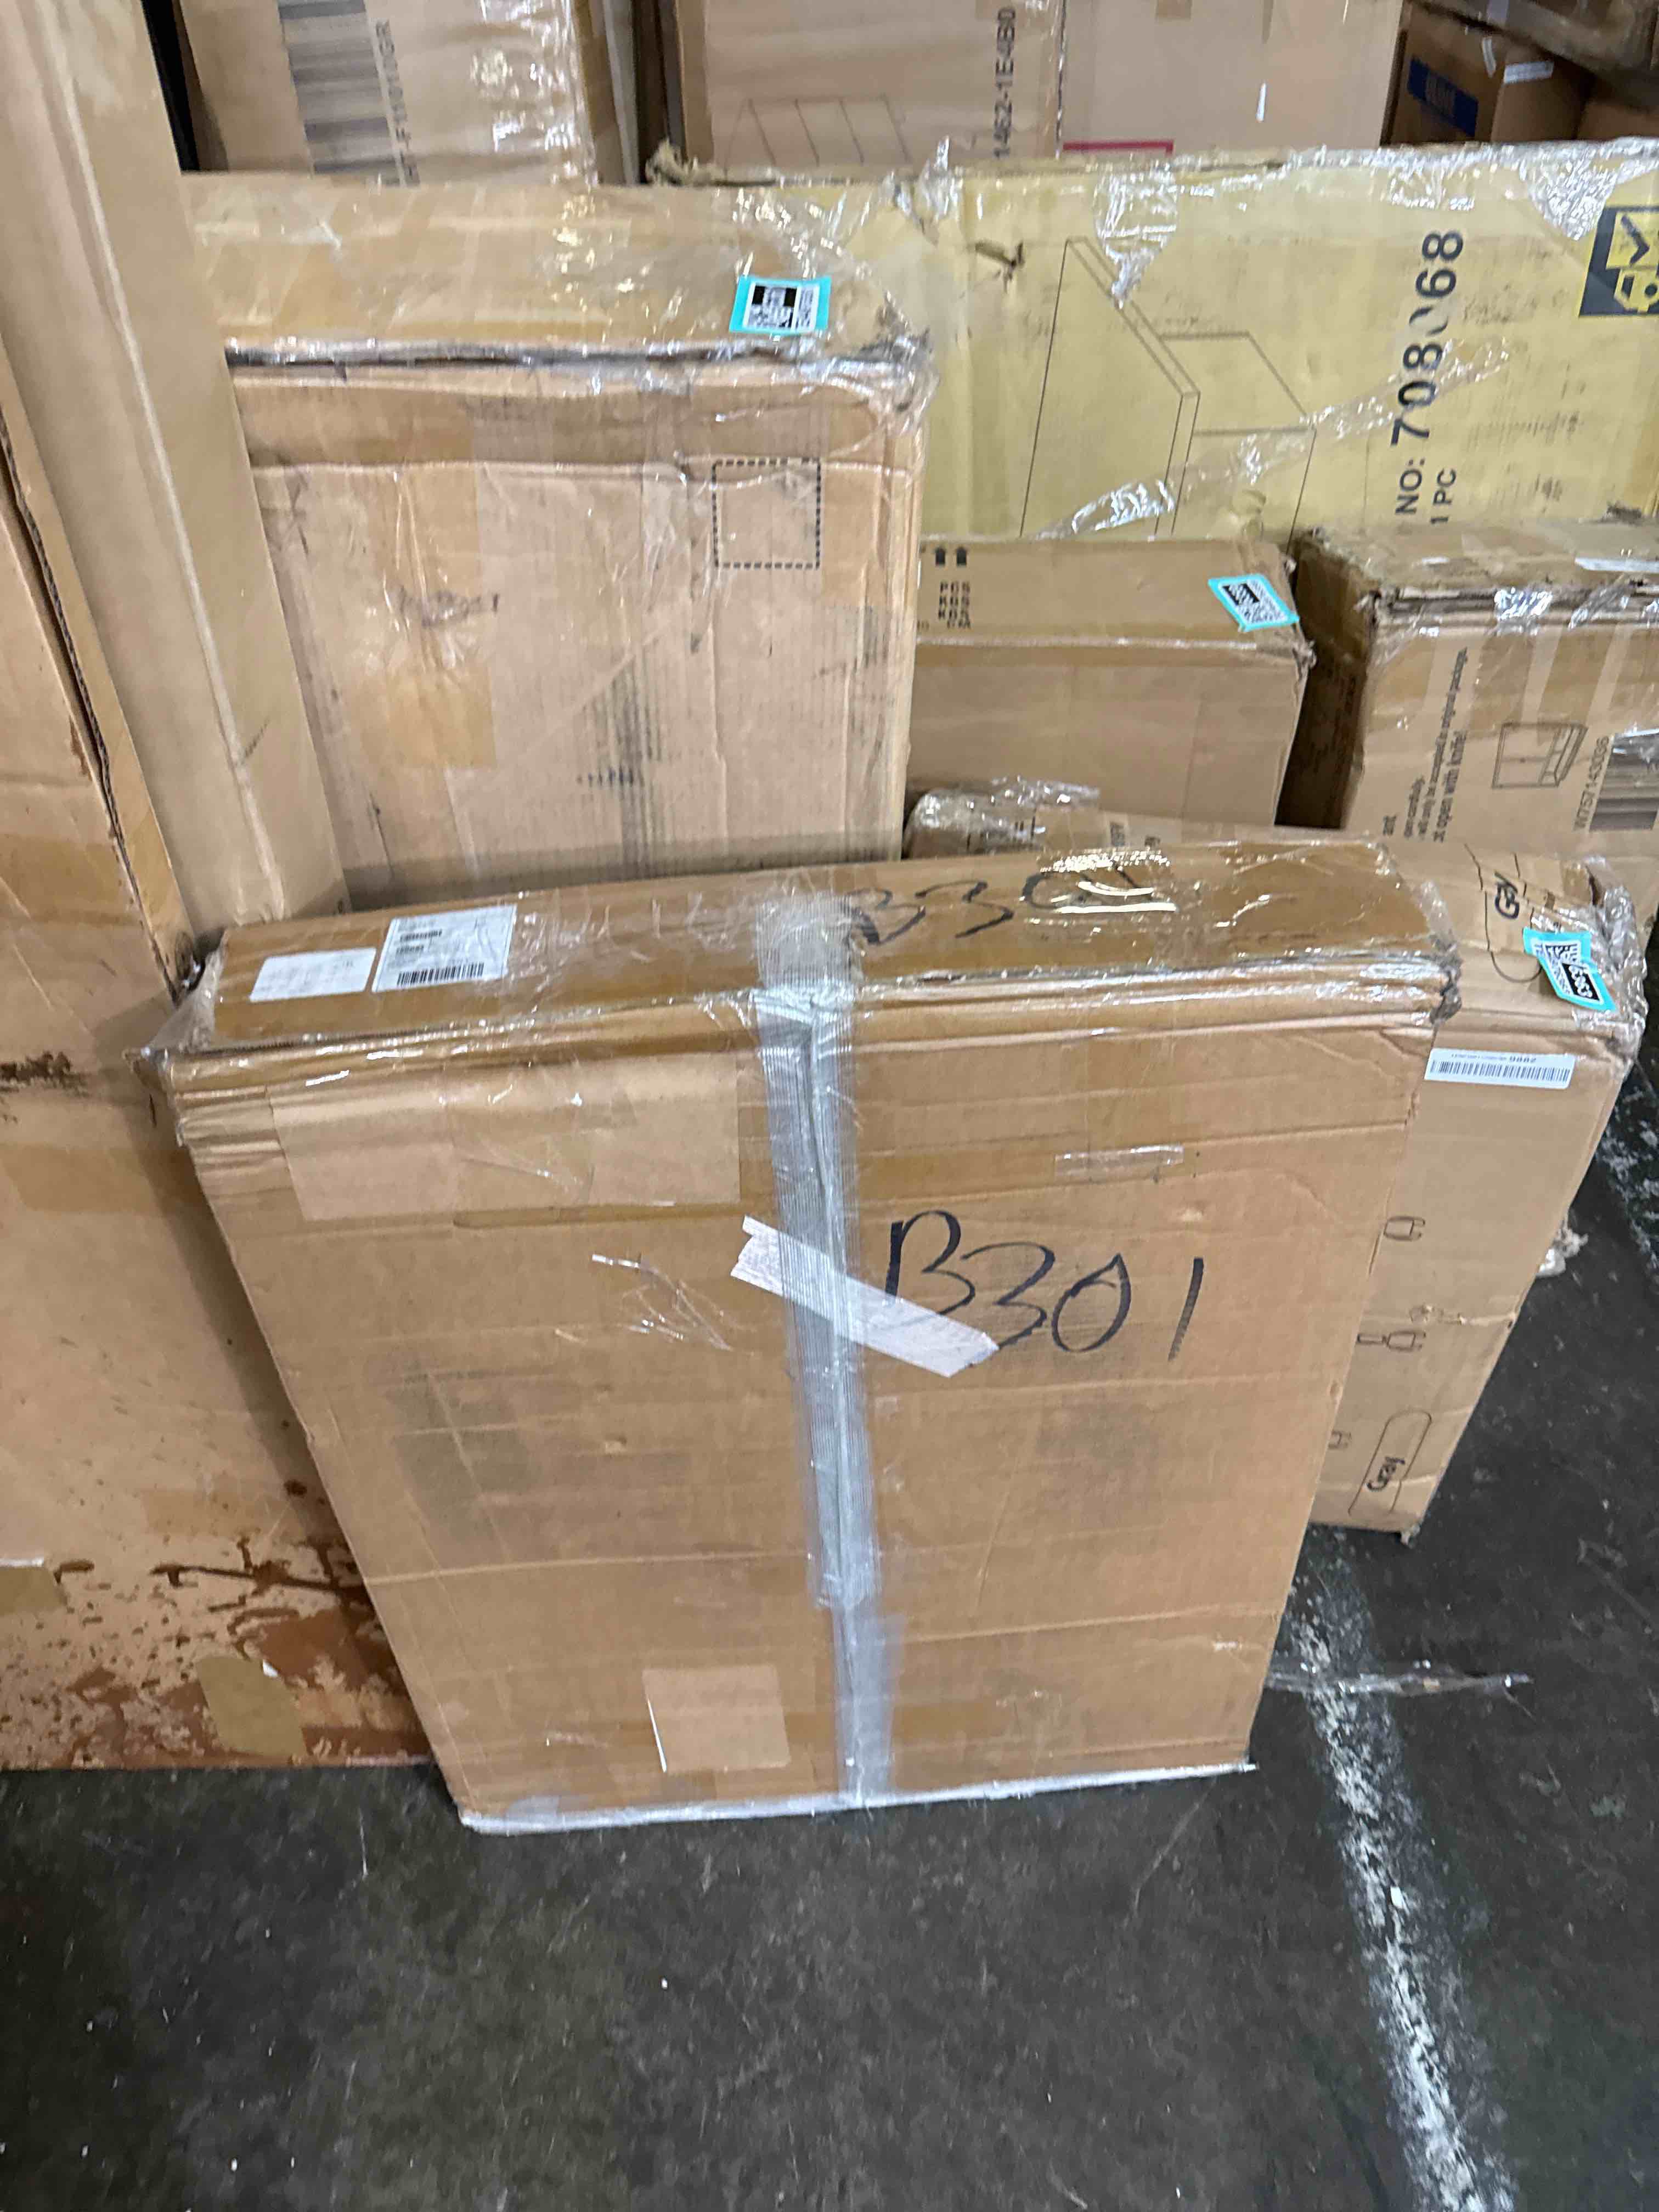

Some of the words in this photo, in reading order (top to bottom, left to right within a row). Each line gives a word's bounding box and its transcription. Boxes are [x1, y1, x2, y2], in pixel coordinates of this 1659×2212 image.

[1395, 459, 1425, 515] NO:
[1432, 467, 1457, 506] PC
[884, 1209, 1204, 1361] B301
